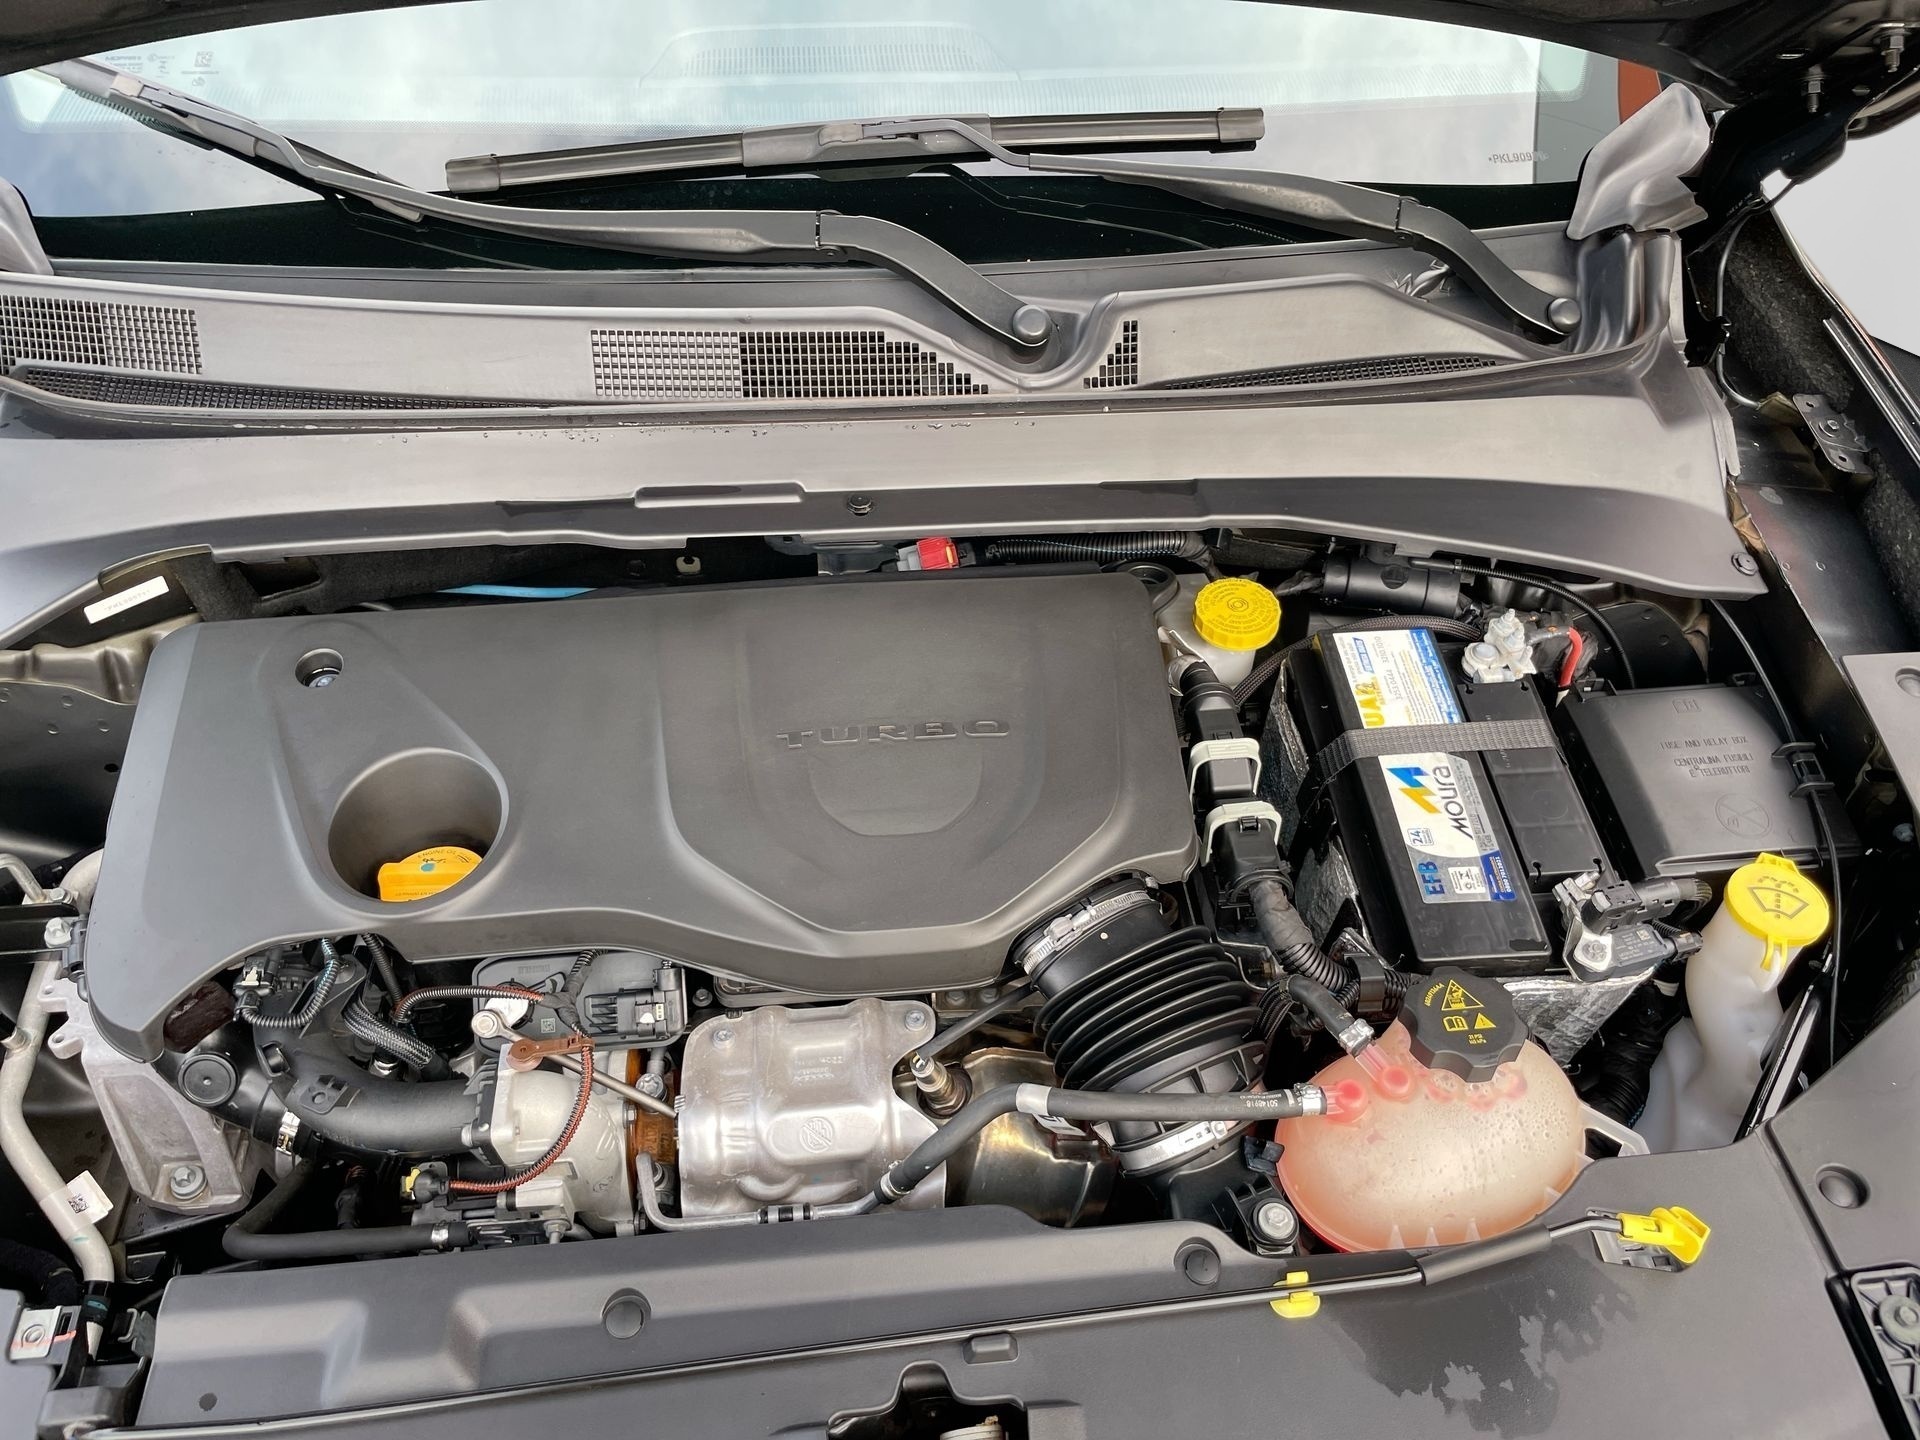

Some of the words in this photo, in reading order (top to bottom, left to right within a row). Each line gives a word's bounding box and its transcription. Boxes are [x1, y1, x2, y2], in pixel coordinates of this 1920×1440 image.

[776, 719, 1010, 749] TURBO
[1685, 738, 1701, 748] AND
[1409, 830, 1424, 844] 24
[1418, 861, 1445, 894] EFB
